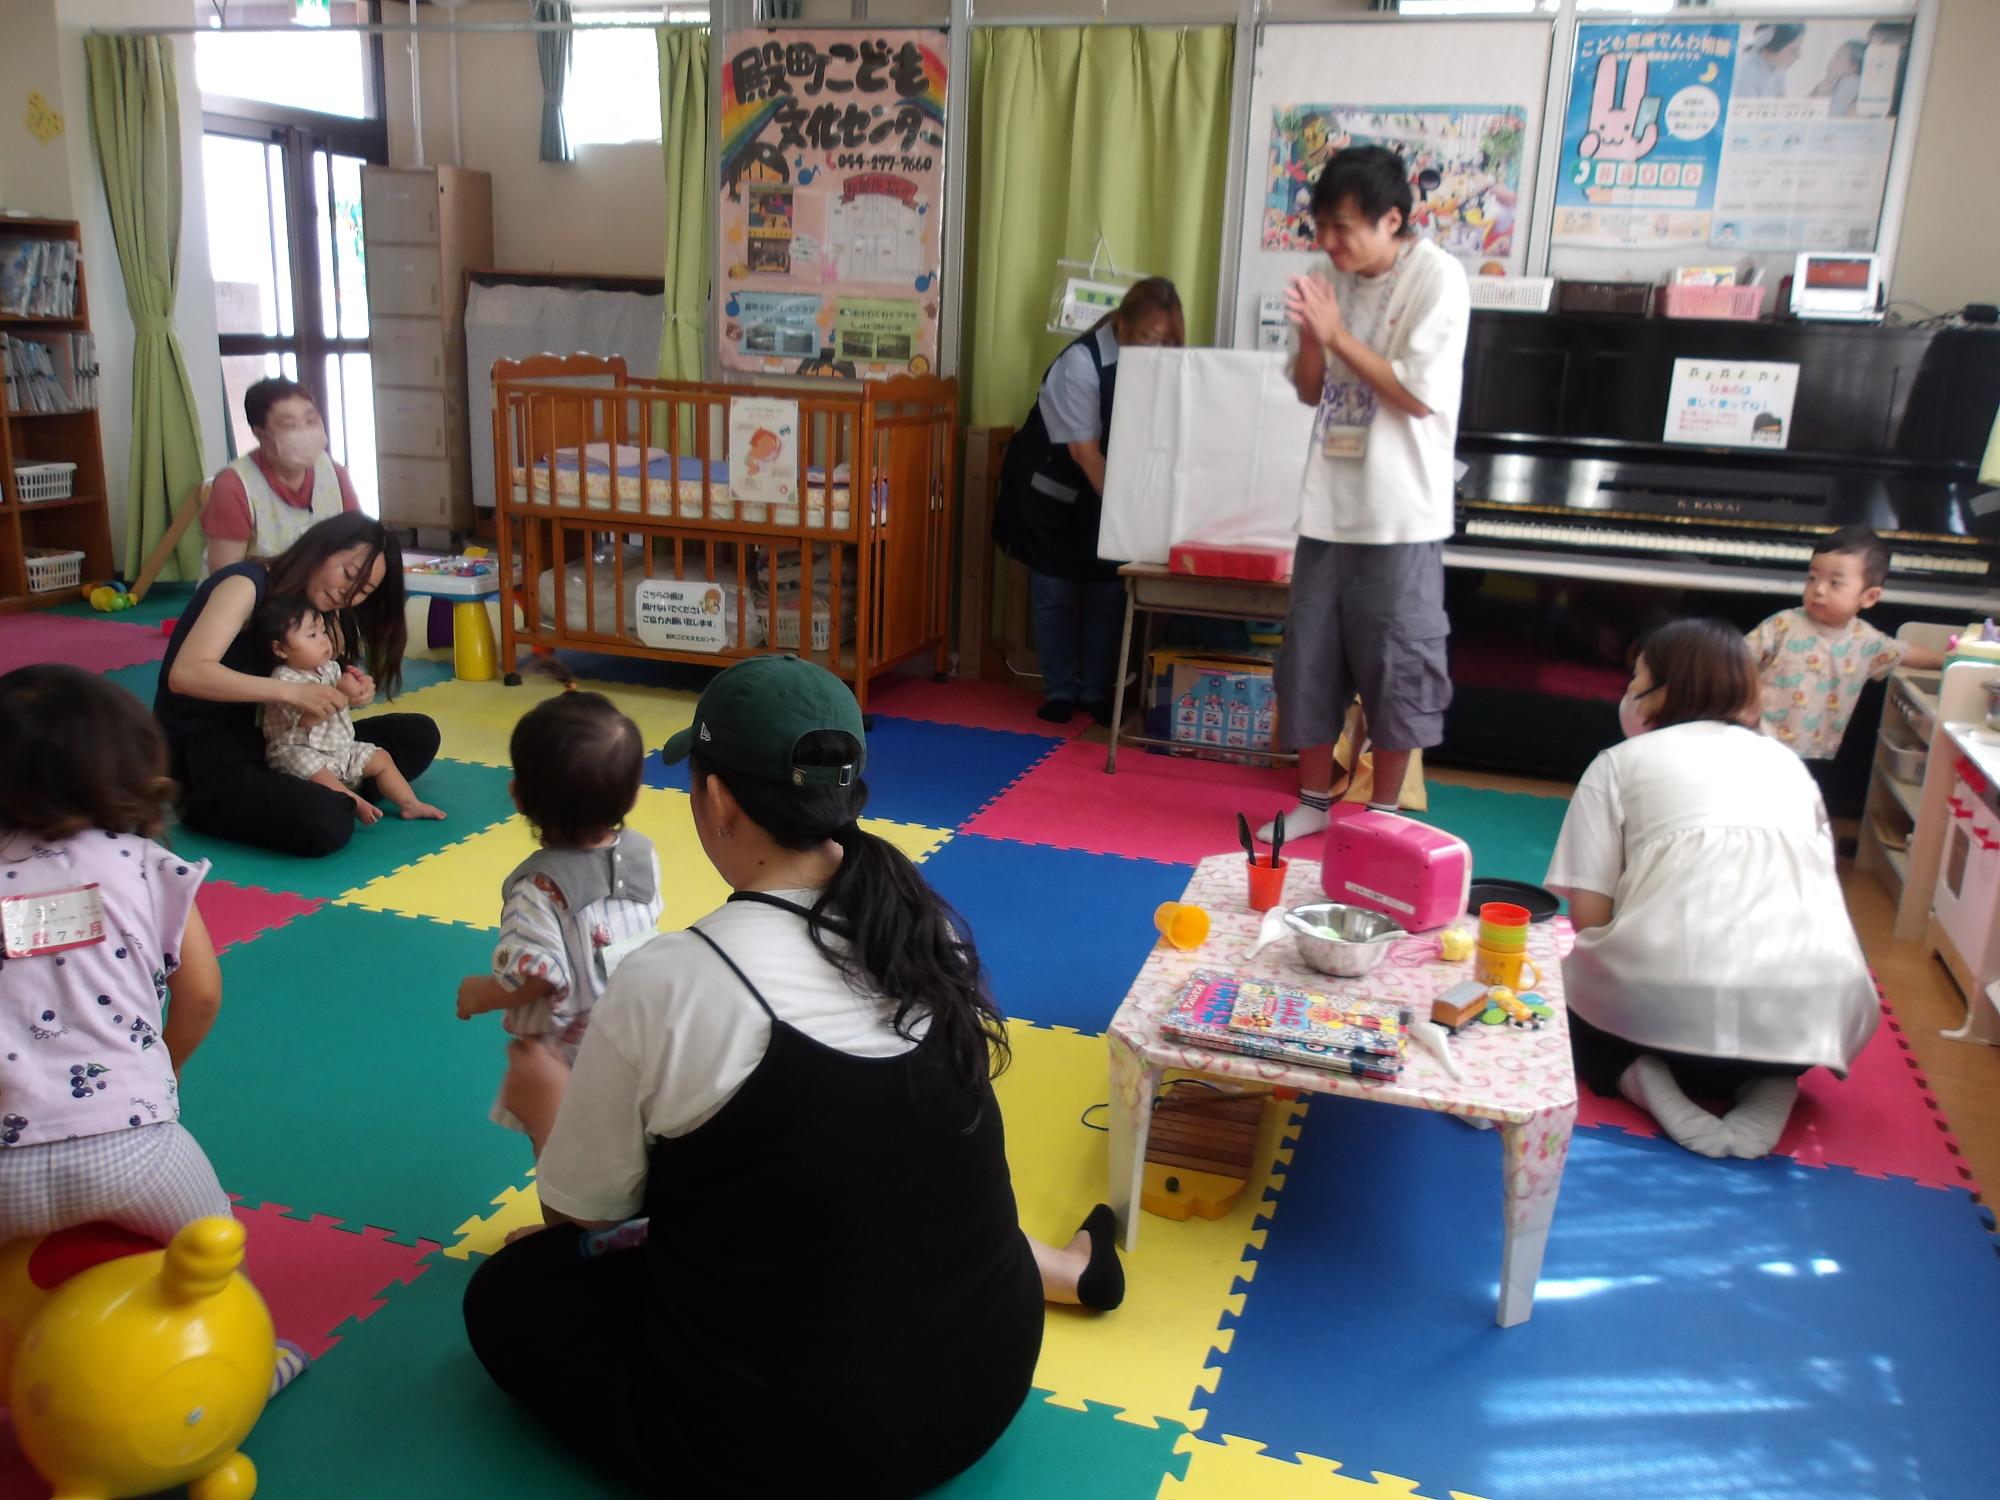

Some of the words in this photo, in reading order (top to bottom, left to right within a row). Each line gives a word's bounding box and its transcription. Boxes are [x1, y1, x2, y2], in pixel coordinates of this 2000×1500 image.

[774, 97, 943, 151] 文化センター
[838, 153, 933, 172] 044-277-7660
[1694, 501, 1741, 512] KAWAI
